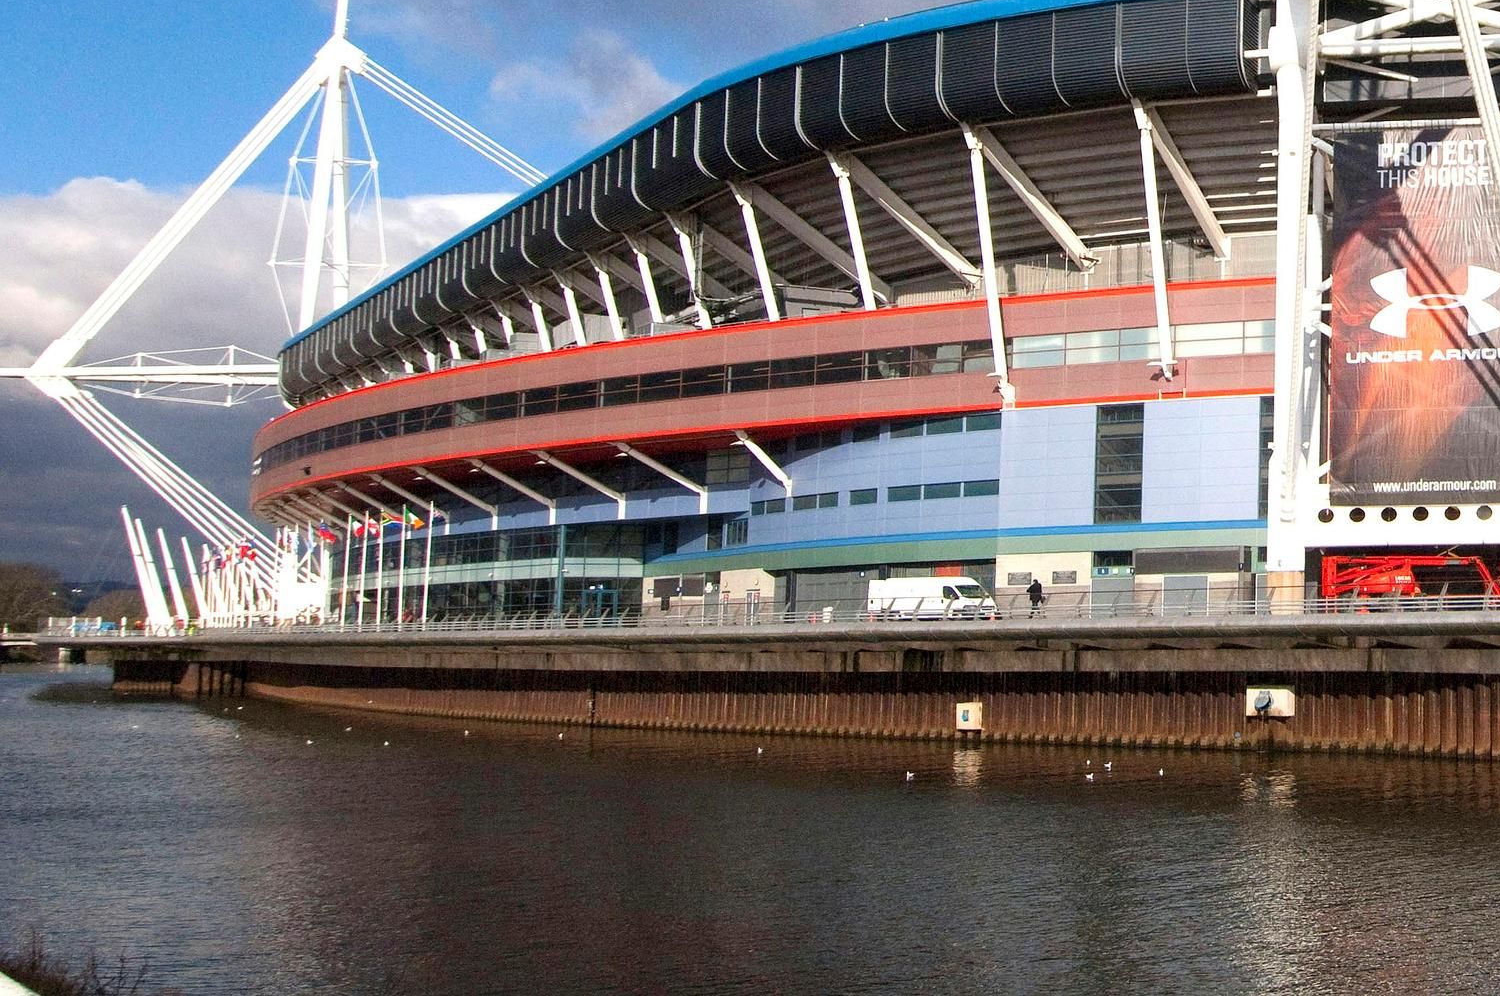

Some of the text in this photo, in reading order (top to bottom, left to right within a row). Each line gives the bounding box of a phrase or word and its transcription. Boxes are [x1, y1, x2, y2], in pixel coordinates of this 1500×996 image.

[1377, 139, 1487, 168] PROTECT
[1377, 169, 1419, 189] THIS
[1345, 350, 1423, 365] UNDER
[1372, 478, 1498, 493] www.underarmour.com
